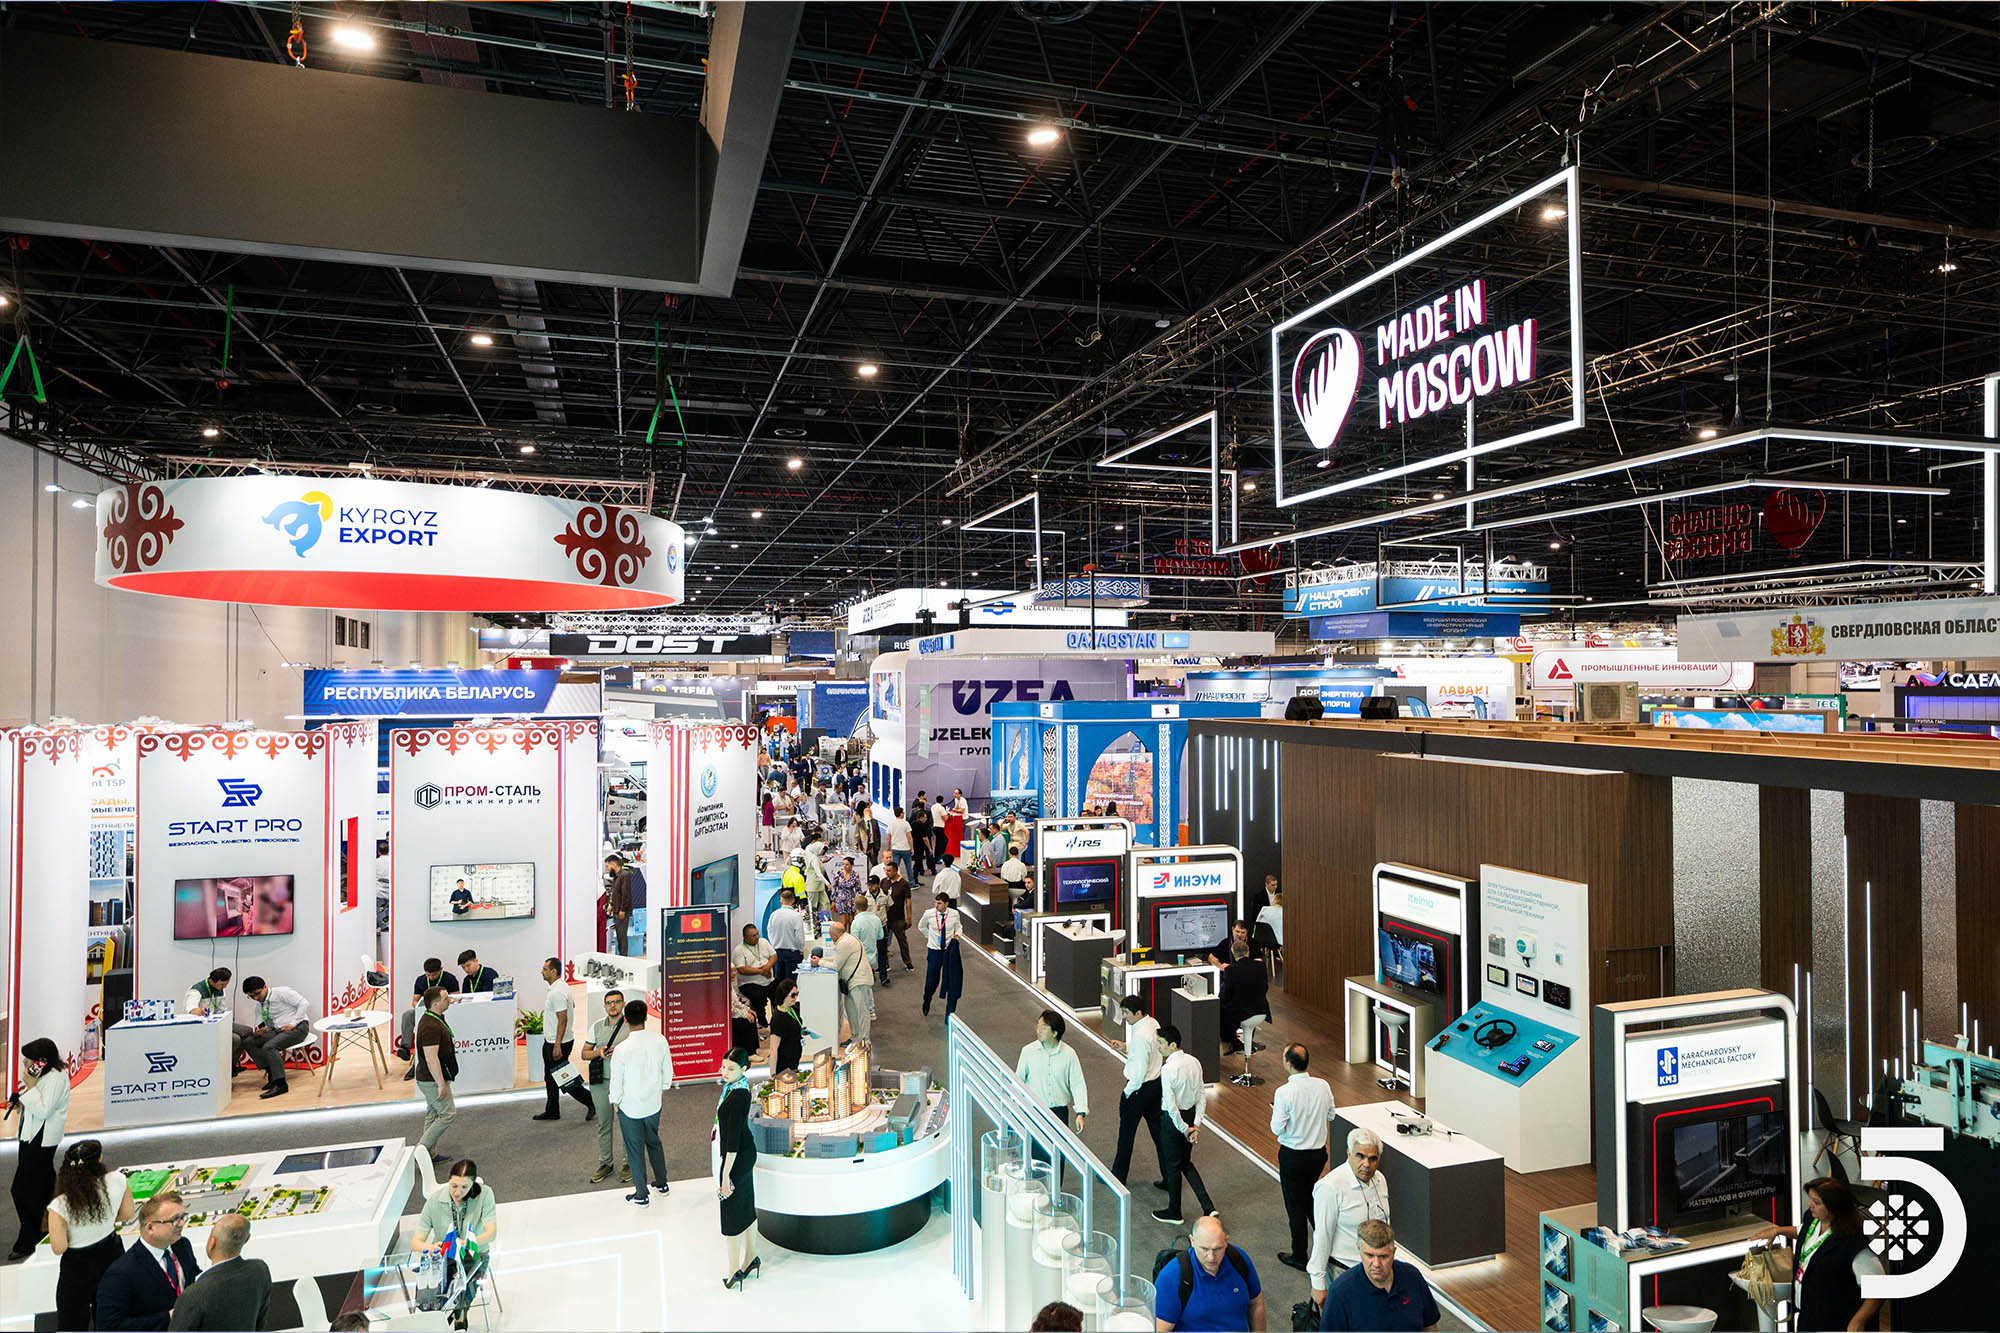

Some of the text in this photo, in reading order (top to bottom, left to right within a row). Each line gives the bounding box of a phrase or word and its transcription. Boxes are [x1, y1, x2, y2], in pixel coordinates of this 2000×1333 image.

[1377, 279, 1486, 366] MADE IN
[1378, 318, 1537, 429] MOSCOW
[339, 506, 438, 527] KYRGYZ
[339, 527, 438, 546] EXPORT
[1309, 586, 1371, 602] НАЦПРОЕКТ
[1309, 599, 1342, 611] СТРОЙ
[1831, 621, 1941, 639] СВЕРДЛОВСКАЯ
[586, 634, 739, 654] DOST
[1581, 663, 1718, 673] ПРОМЫШЛЕННЫЕ ИННОВАЦИИ
[323, 685, 536, 700] РЕСПУБЛИКА БЕЛАРУСЬ
[1321, 690, 1365, 698] ЭНЕРГЕТИКА
[445, 785, 541, 797] ПРОМ-СТАЛЬ
[168, 819, 302, 836] START PRO
[1078, 839, 1101, 848] iRS
[1174, 874, 1221, 888] ИНЭУМ
[1681, 1045, 1741, 1060] KARACHAROVSKY
[1681, 1052, 1756, 1069] MECHANICAL FACTORY
[111, 1078, 210, 1095] START PRO
[1659, 1075, 1677, 1085] КМЗ
[1688, 1194, 1731, 1208] МАТЕРИАЛОВ
[1738, 1186, 1776, 1199] ФУРНИТУРЫ
